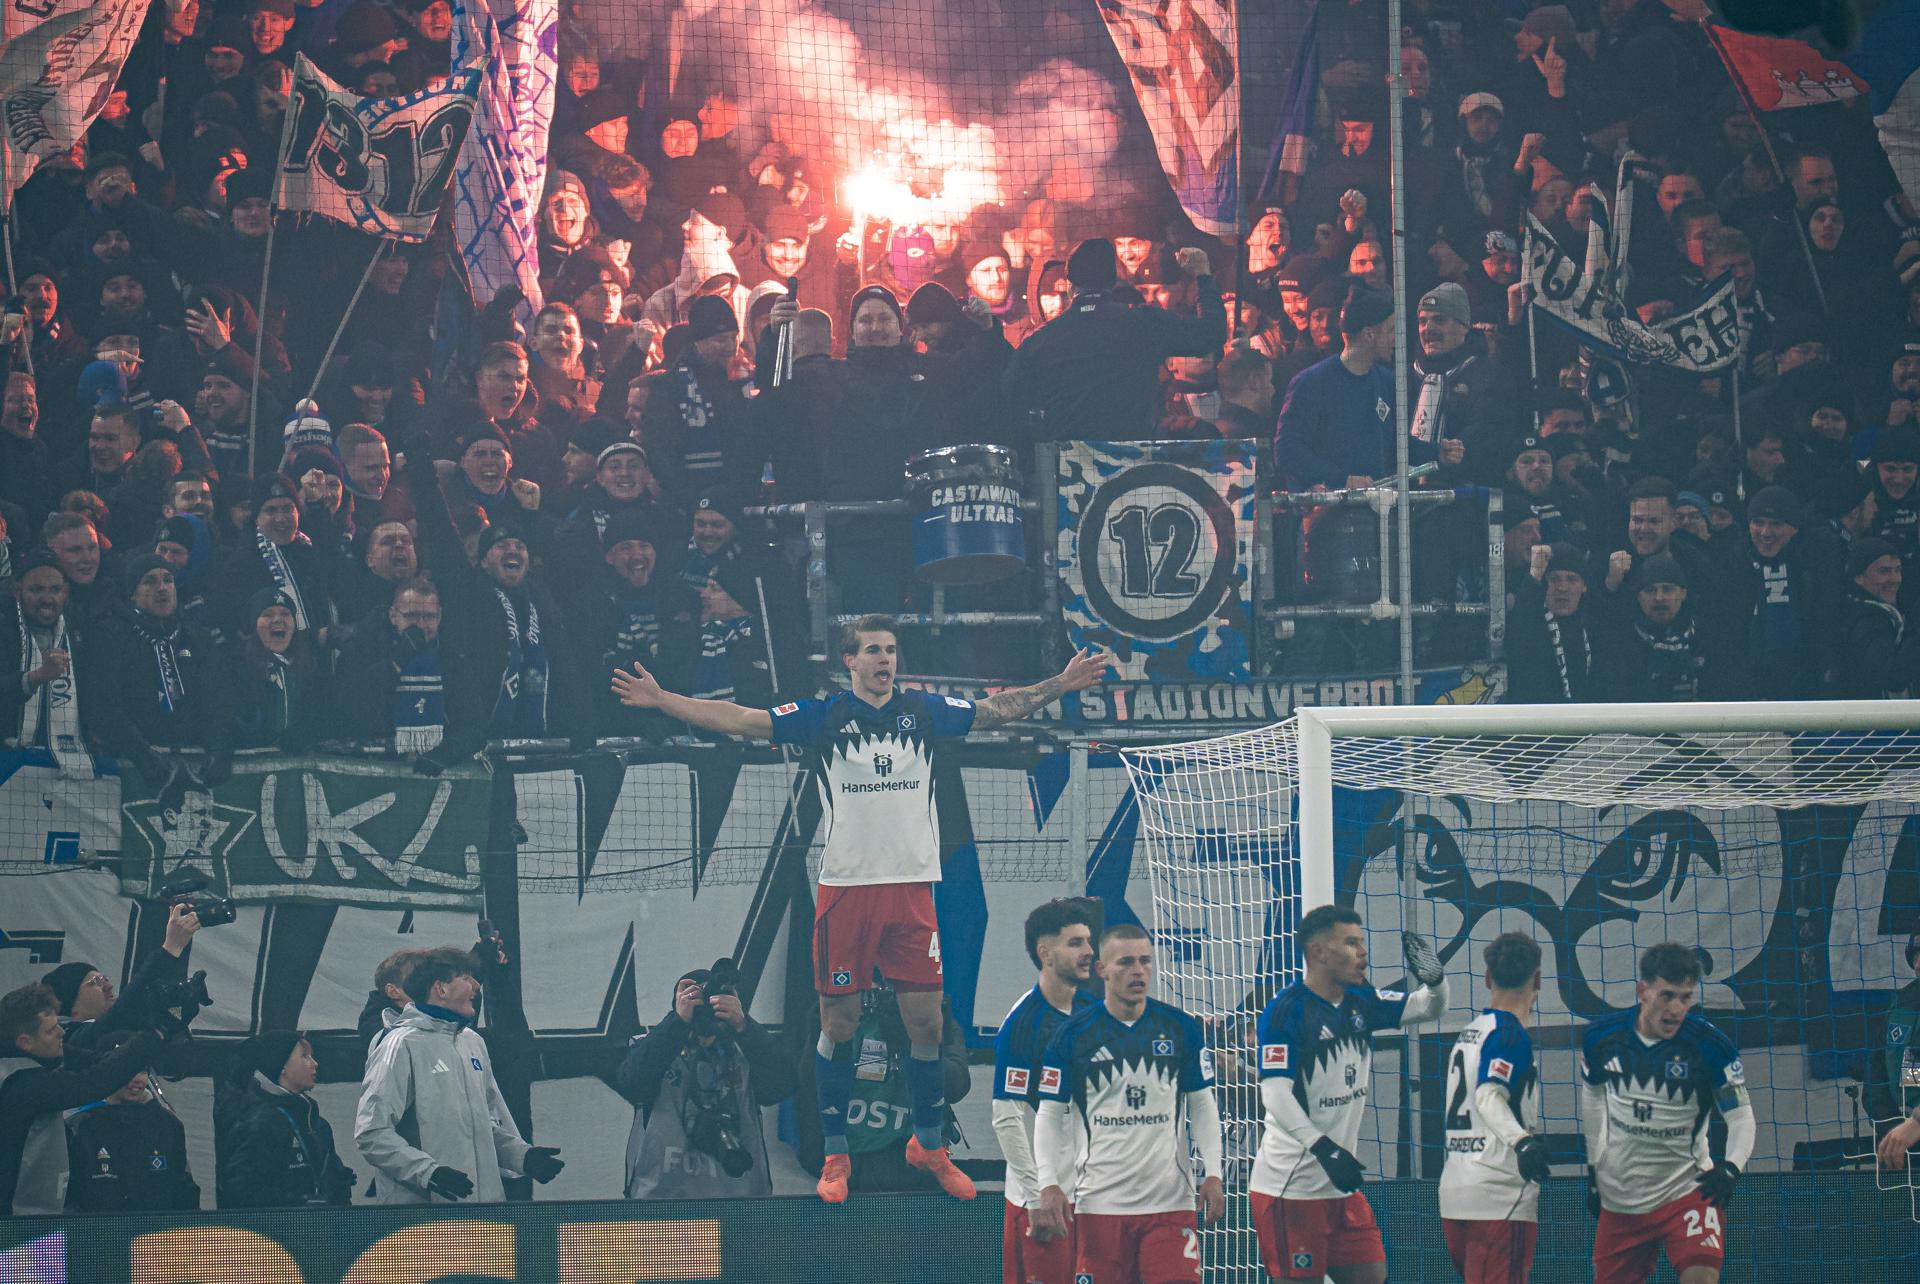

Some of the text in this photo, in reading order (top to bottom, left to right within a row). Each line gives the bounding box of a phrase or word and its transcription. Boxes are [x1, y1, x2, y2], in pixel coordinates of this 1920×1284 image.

[951, 505, 1014, 524] ULTRAS
[1108, 503, 1201, 599] 12
[1079, 679, 1421, 721] STADIONVERBOT
[842, 779, 920, 793] HanseMerkur
[1446, 1049, 1473, 1130] 2
[1683, 1206, 1721, 1238] 24
